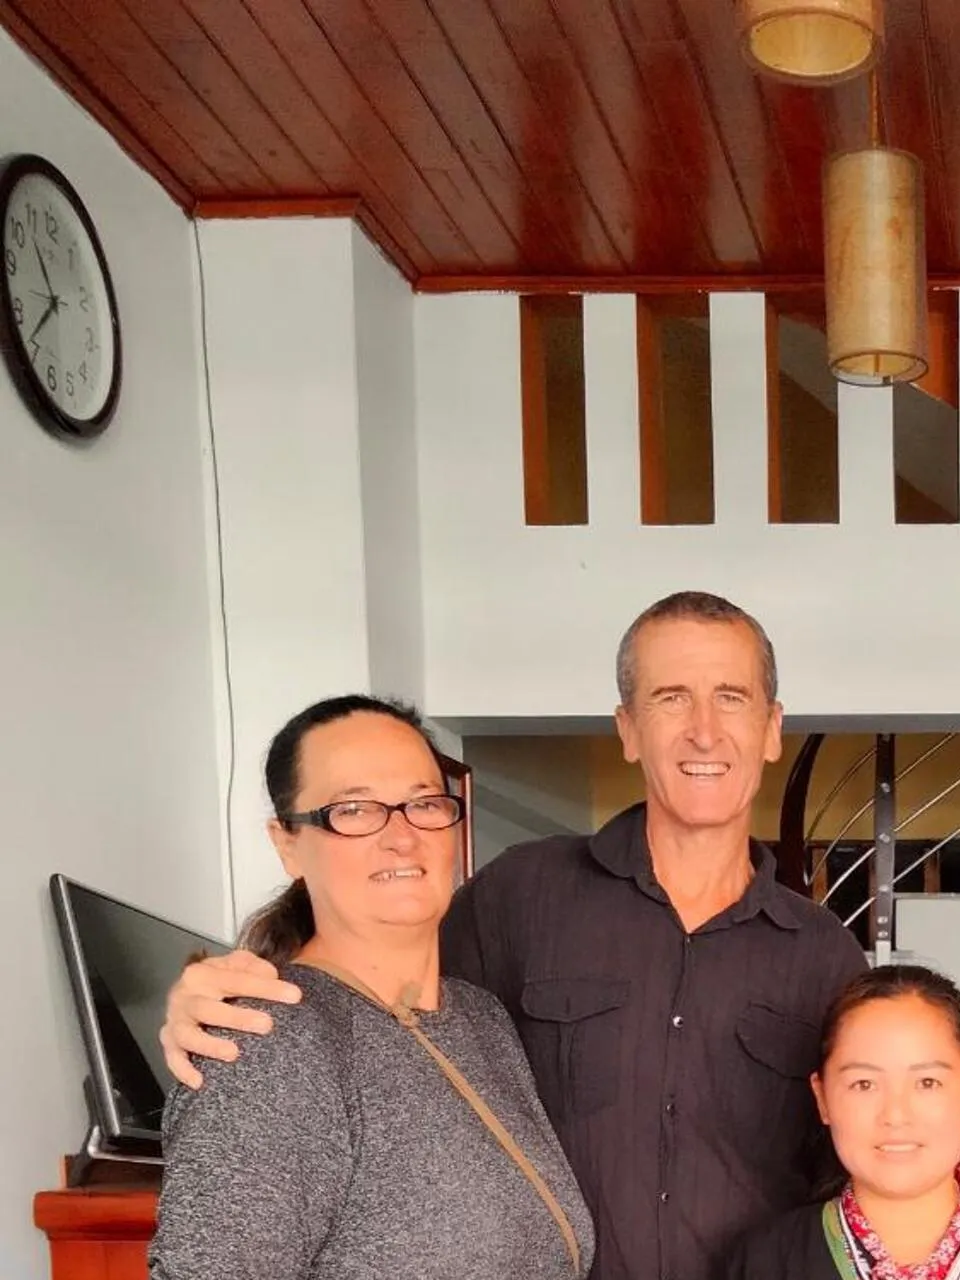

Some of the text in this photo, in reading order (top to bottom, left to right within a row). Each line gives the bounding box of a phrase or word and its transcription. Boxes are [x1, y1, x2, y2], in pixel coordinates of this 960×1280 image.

[25, 203, 37, 234] 11
[44, 209, 59, 244] 12
[10, 217, 25, 248] 10
[6, 249, 17, 276] 9
[28, 338, 40, 365] 7
[47, 365, 57, 392] 6
[65, 371, 75, 396] 5
